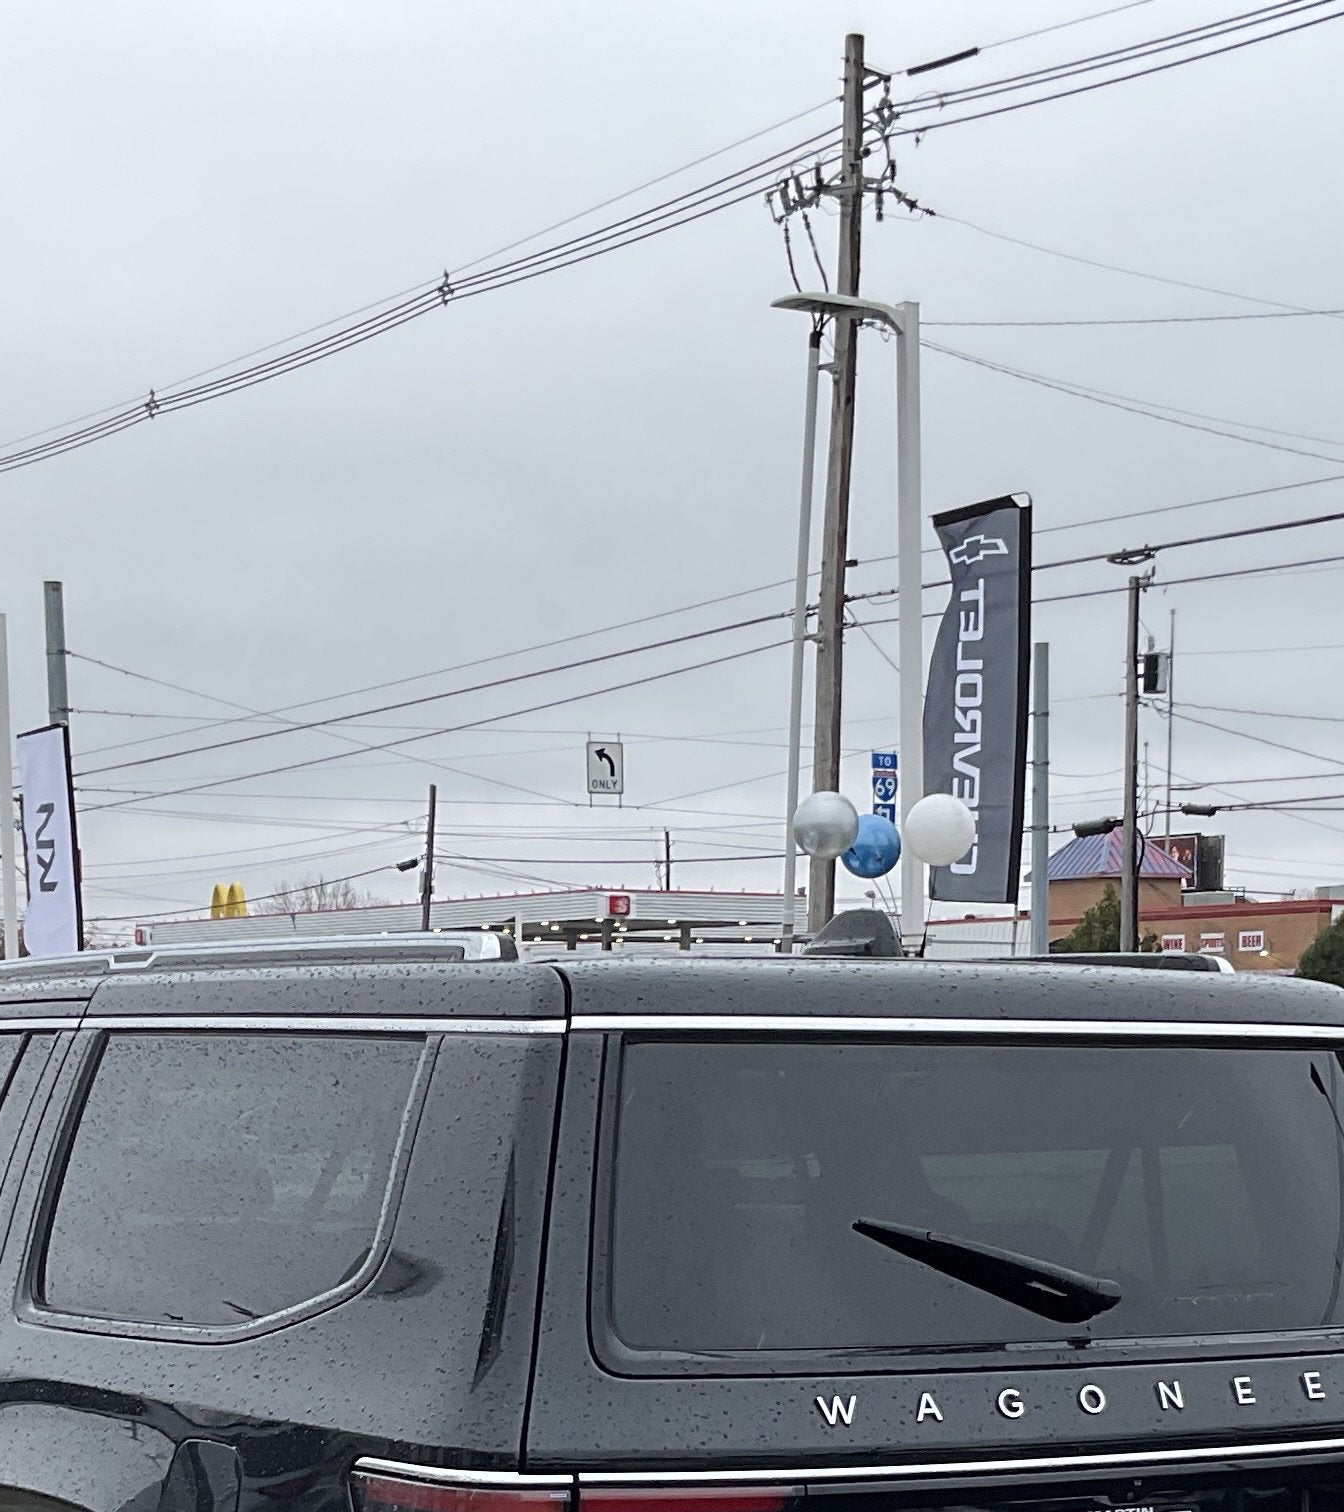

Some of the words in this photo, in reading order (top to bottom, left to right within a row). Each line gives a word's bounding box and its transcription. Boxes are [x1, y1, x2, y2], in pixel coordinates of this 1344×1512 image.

[878, 756, 892, 767] TO
[591, 779, 618, 790] ONLY
[876, 778, 896, 796] 69
[1241, 935, 1262, 948] BEER
